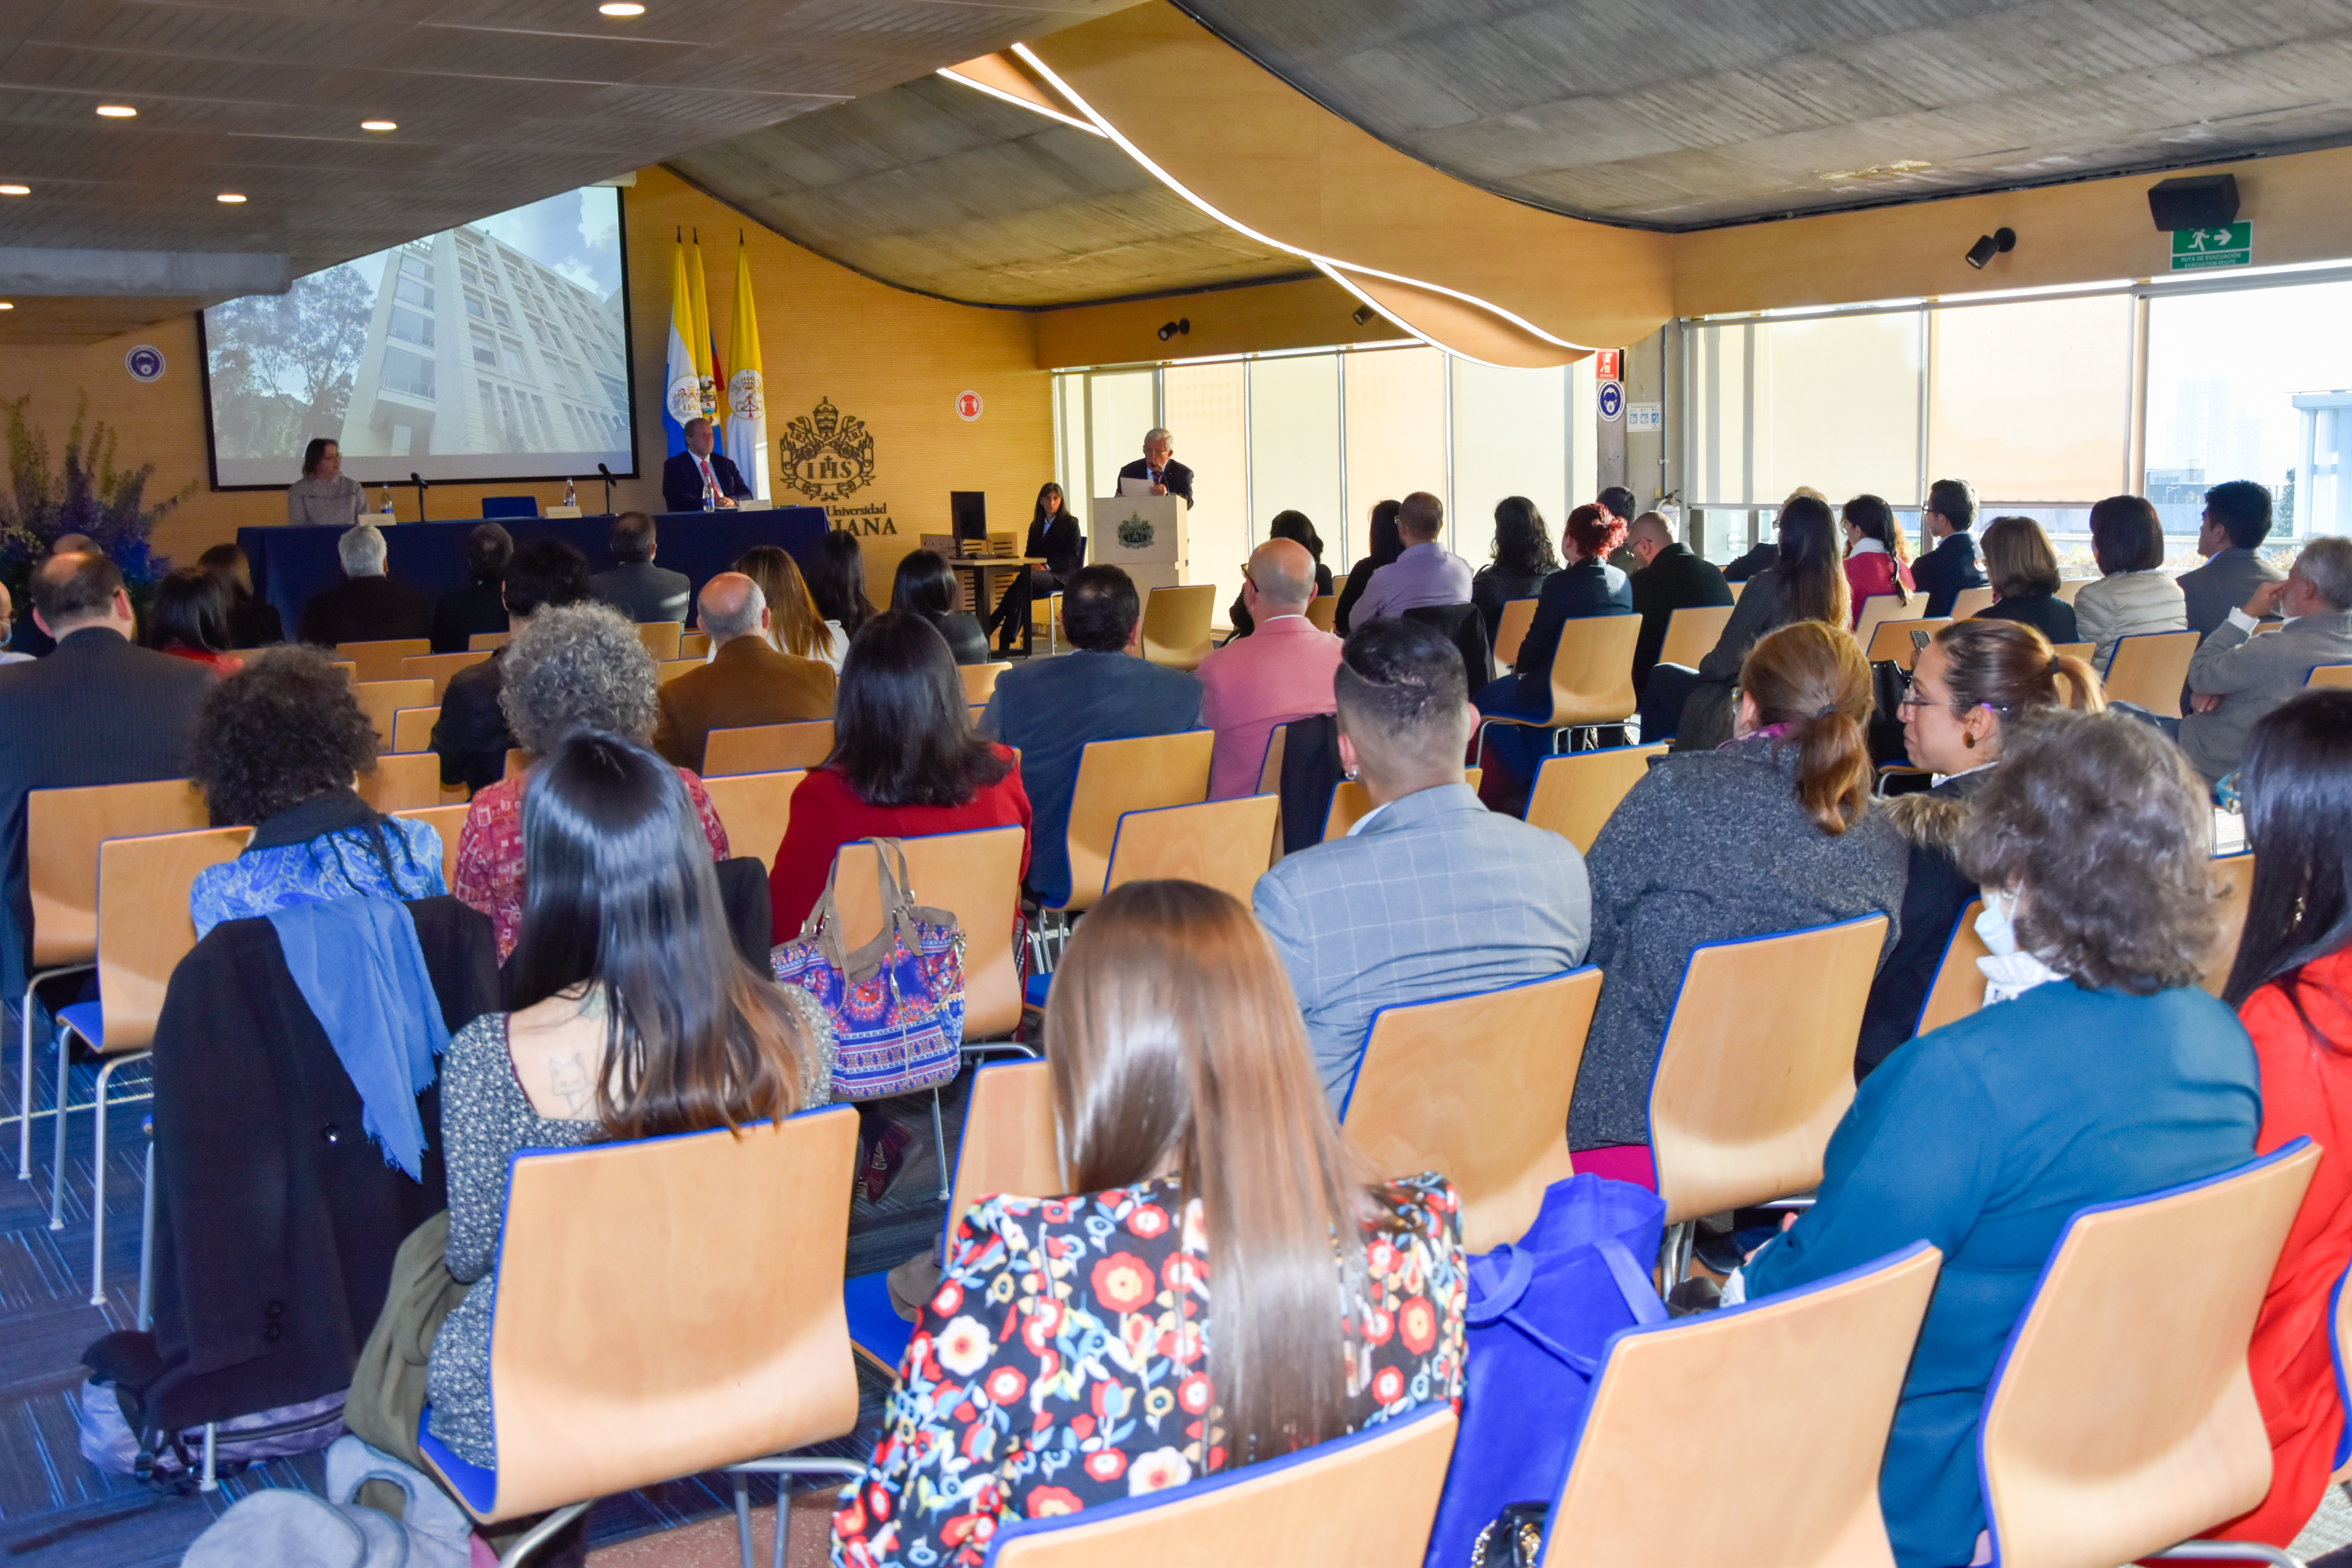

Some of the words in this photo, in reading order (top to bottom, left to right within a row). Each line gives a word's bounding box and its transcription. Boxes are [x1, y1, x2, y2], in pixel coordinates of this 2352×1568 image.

[2205, 252, 2241, 261] EVACUACIÓN
[807, 458, 853, 479] IHS
[826, 502, 887, 517] Universidad
[835, 517, 898, 536] IANA
